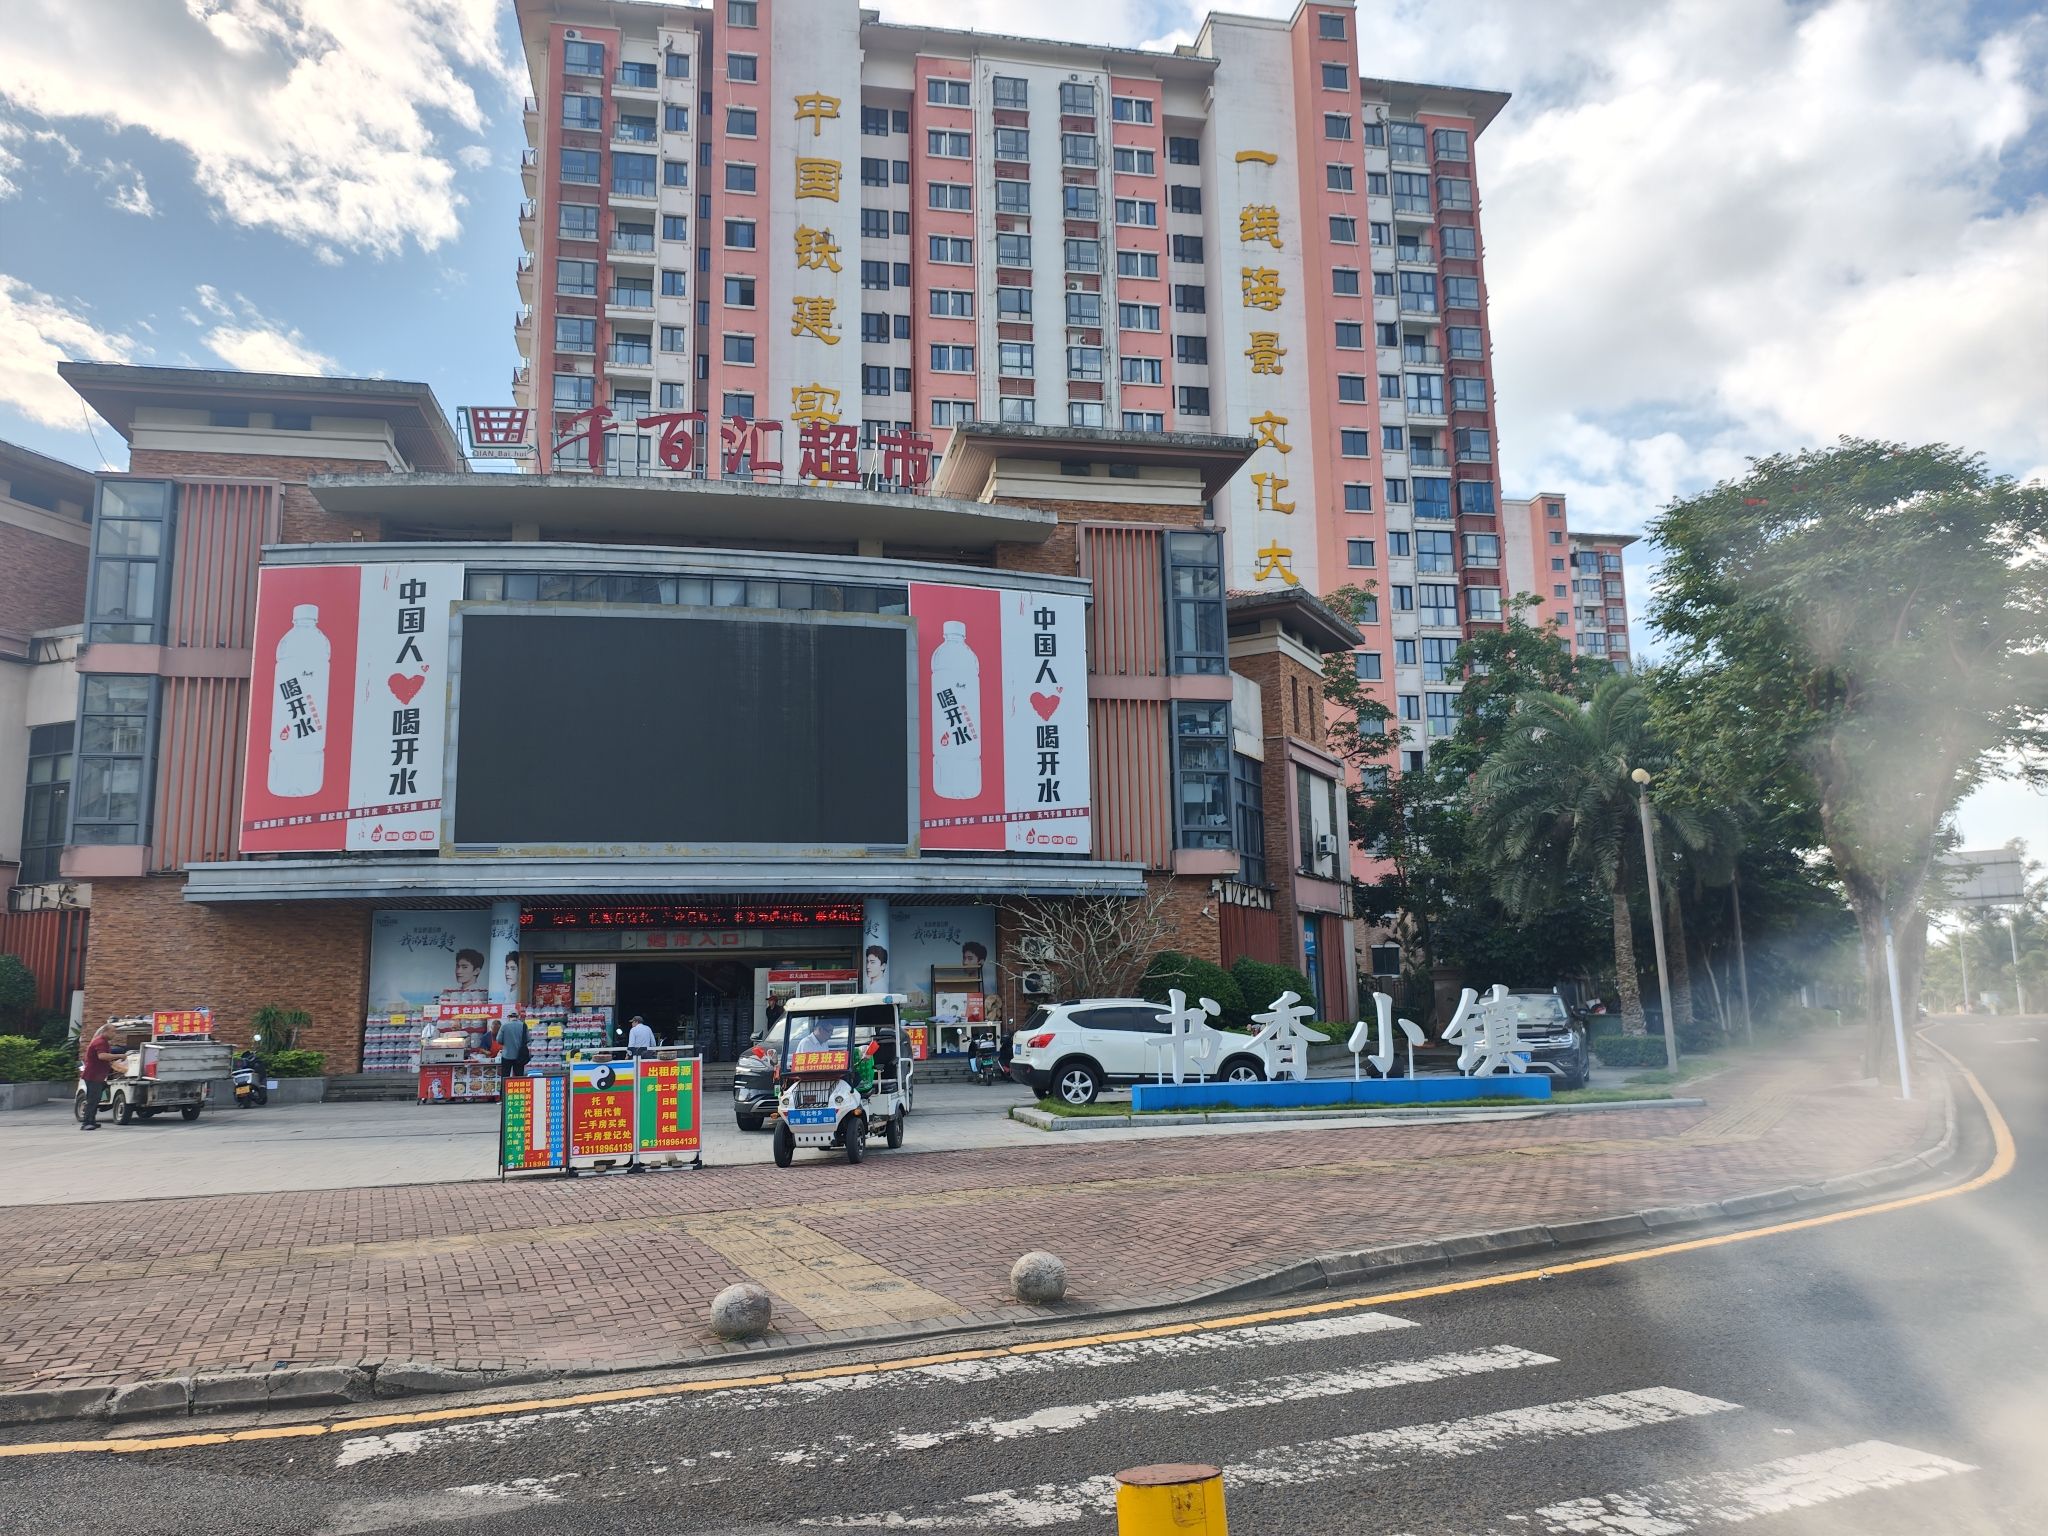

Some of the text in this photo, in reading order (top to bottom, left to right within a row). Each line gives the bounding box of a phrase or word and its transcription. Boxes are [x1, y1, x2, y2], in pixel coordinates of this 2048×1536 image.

[791, 91, 842, 488] 中国铁建实
[553, 406, 933, 487] 千百汇超市
[389, 578, 426, 795] 中国人 喝开水
[280, 677, 316, 739] 喝开水
[1034, 606, 1060, 803] 中国人 喝开水
[937, 688, 972, 745] 喝开水
[1145, 984, 1535, 1085] 书香小镇
[795, 1051, 846, 1066] 看房班车
[648, 1065, 692, 1077] 出租房源
[646, 1082, 693, 1093] 多套二手房源
[591, 1095, 616, 1106] 托管
[662, 1097, 678, 1105] 日租
[584, 1107, 622, 1118] 代租代售
[662, 1111, 677, 1120] 月租
[579, 1119, 627, 1130] 二手房买卖
[661, 1124, 677, 1133] 长租
[574, 1130, 632, 1142] 二手房登记处
[650, 1137, 698, 1147] 13118964139
[580, 1143, 633, 1154] 13118964139
